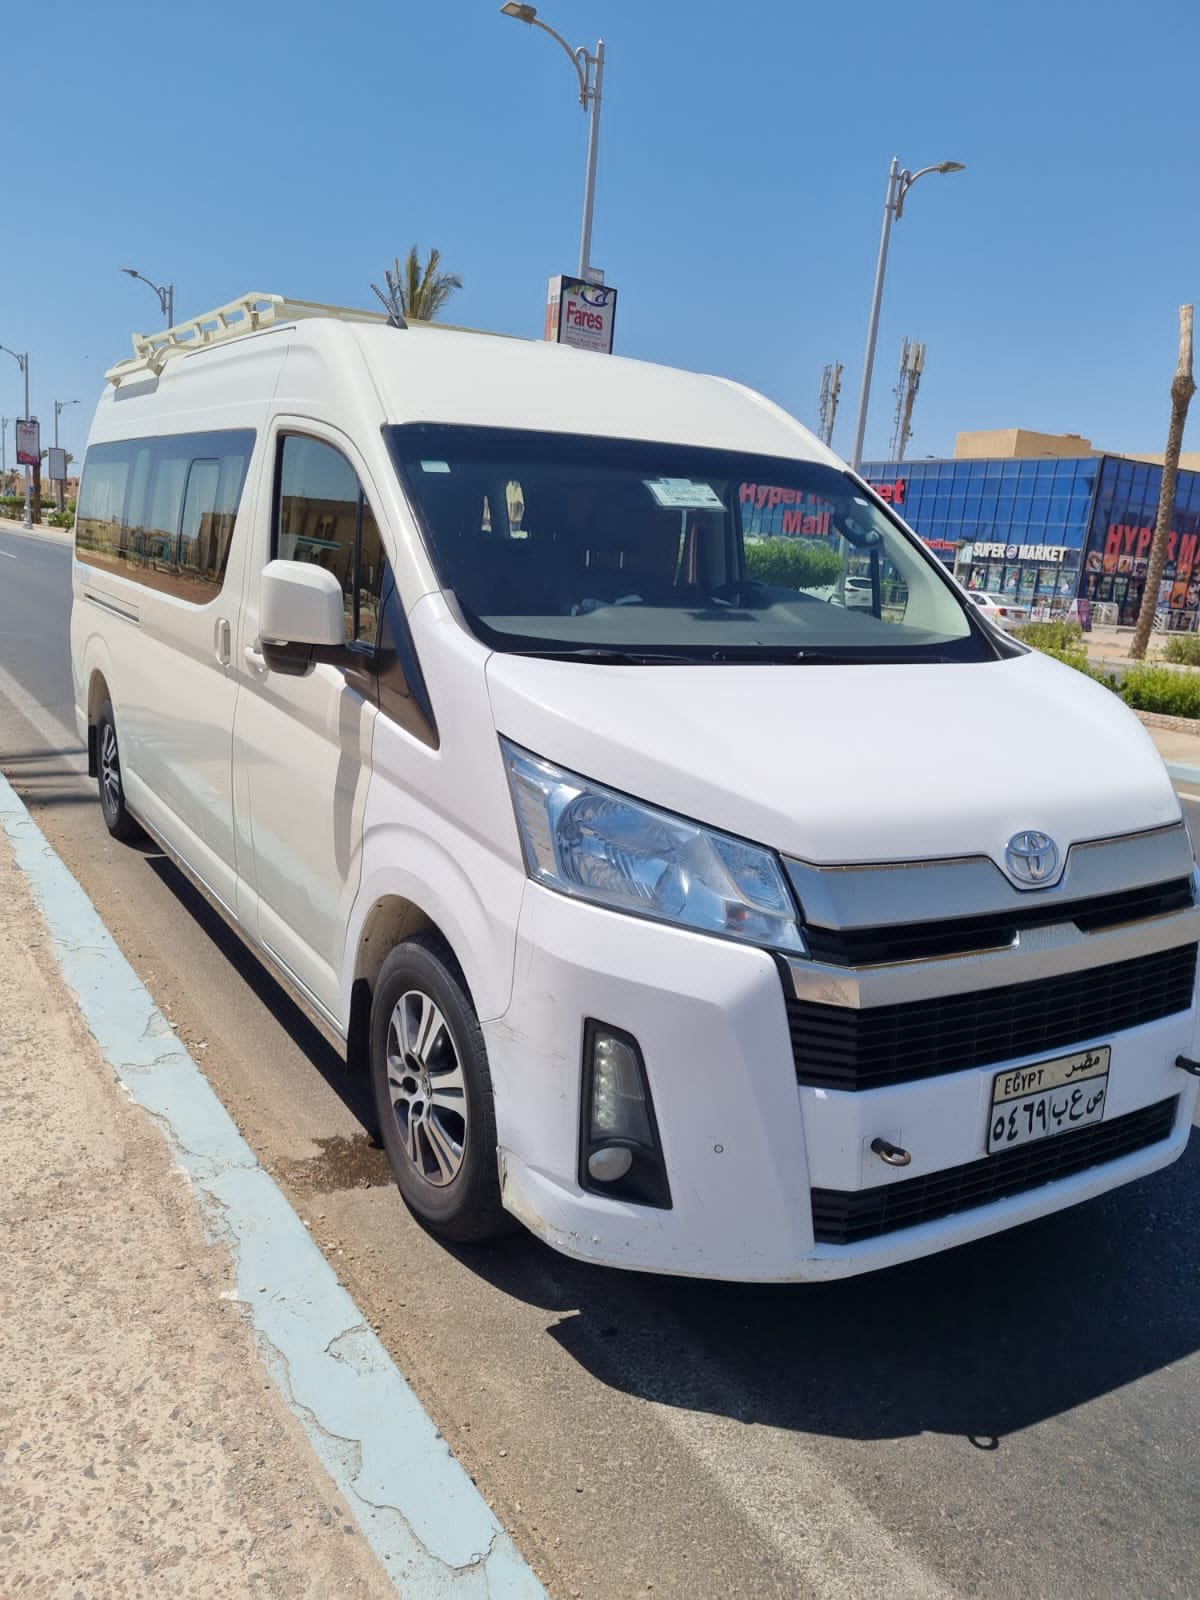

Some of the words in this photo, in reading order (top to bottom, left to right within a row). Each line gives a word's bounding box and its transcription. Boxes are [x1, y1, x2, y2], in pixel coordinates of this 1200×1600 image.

[566, 301, 603, 331] Fares
[739, 482, 803, 509] Hyper
[782, 511, 830, 536] Mall
[972, 542, 1006, 559] SUPER
[1018, 543, 1067, 562] MARKET
[1104, 523, 1177, 562] HYPR
[1065, 1053, 1101, 1078] مصر
[1004, 1069, 1045, 1096] EGYPT
